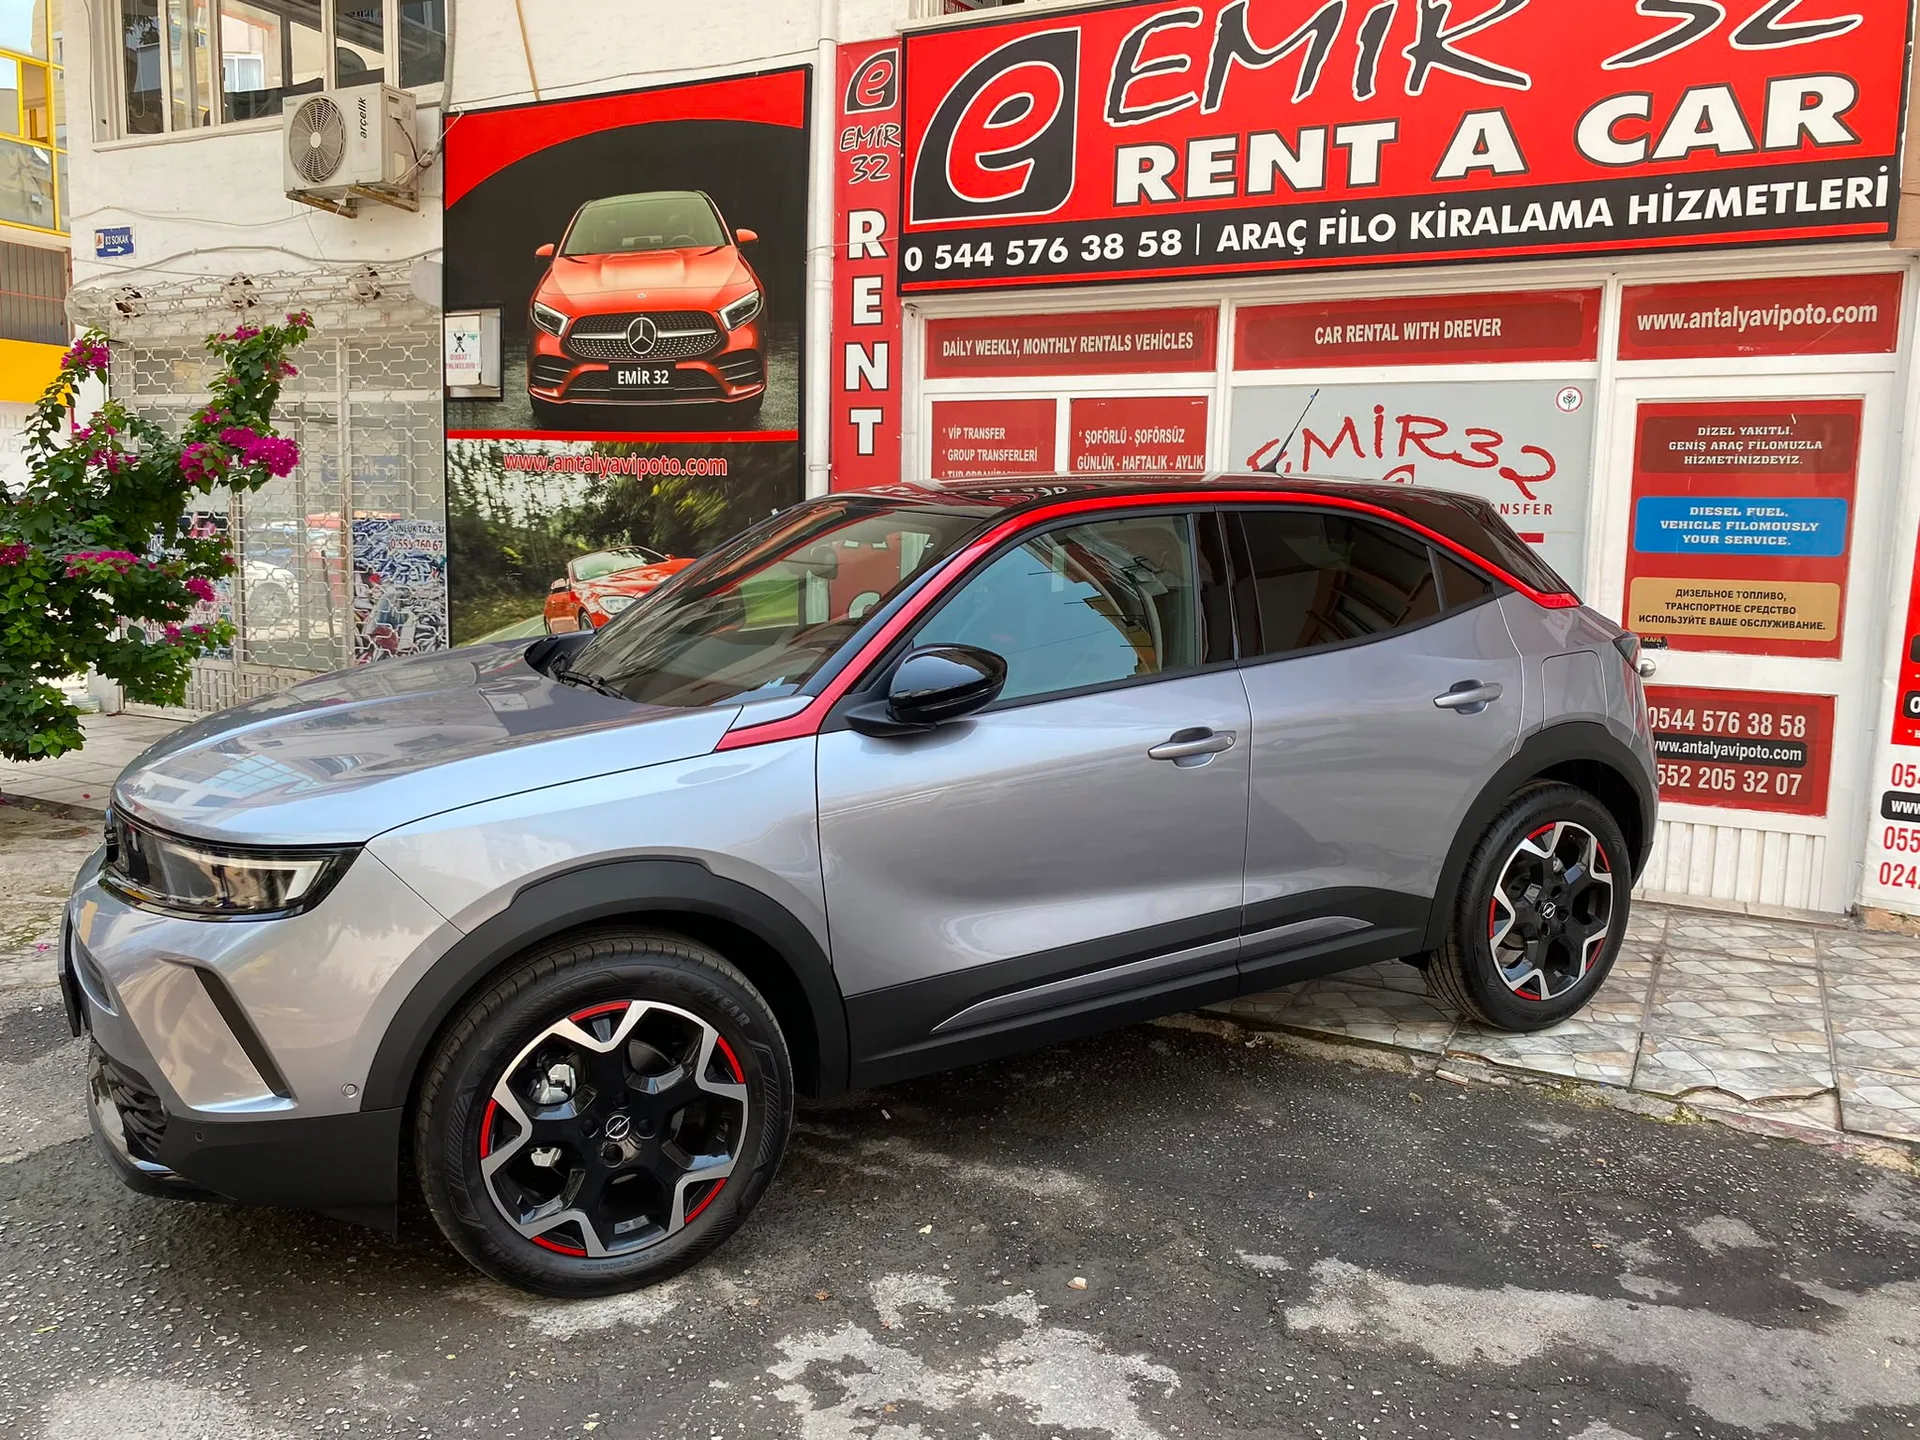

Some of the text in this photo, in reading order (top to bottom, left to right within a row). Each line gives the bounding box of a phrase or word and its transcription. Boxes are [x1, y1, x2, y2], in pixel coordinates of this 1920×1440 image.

[358, 97, 369, 139] arçelik
[839, 124, 901, 153] EMİR
[1114, 72, 1862, 206] RENT A CAR
[848, 154, 891, 185] 32
[904, 165, 1887, 271] 0 544 576 38 58 ARAÇ FİLO KİRALAMA HİZMETLERİ
[111, 234, 129, 245] SOKAK
[1637, 304, 1878, 333] www.antalyavipoto.com
[845, 208, 888, 457] RENT
[1314, 318, 1502, 345] CAR RENTAL WITH DREVER
[975, 339, 1020, 358] WEEKLY,
[1023, 337, 1077, 355] MONTHLY
[1080, 334, 1131, 353] RENTALS
[1136, 329, 1194, 350] VEHİCLES
[617, 367, 669, 385] EMİR 32
[963, 427, 1006, 440] TRANSFER
[1085, 427, 1127, 448] ŞOFÖRLÜ
[1134, 426, 1185, 447] ŞOFÖRSÜZ
[1698, 425, 1793, 436] DİZEL YAKITLI.
[947, 446, 1038, 462] GROUP TRANSFERLERİ
[1669, 439, 1823, 452] GENİŞ ARAÇ FİLOMUZLA
[504, 452, 727, 481] www.antalyavipoto.com
[1077, 453, 1115, 470] GÜNLÜK
[1122, 455, 1167, 470] HAFTALIK
[1175, 455, 1204, 470] AYLIK
[1684, 454, 1803, 465] HİZMETİNİZDEYİZ.
[1491, 503, 1552, 515] NSFER
[1690, 507, 1789, 517] DIESEL FUEL.
[1660, 520, 1819, 532] VEHICLE FILOMOUSLY
[1682, 535, 1791, 546] YOUR SERVICE.
[1675, 589, 1787, 602] ДИЗЕЛЬНОЕ ТОПЛИВО,
[1665, 602, 1796, 615] ТРАНСПОРТНОЕ СРЕДСТВО
[1638, 614, 1826, 630] ИСПОЛЬЗУЙТЕ ВАШЕ ОБСЛУЖИВАНИЕ.
[1648, 706, 1806, 738] 0544 576 38 58
[1698, 767, 1736, 791] 205
[1742, 770, 1769, 794] 32
[1775, 773, 1802, 796] 07
[1879, 862, 1920, 889] 024
